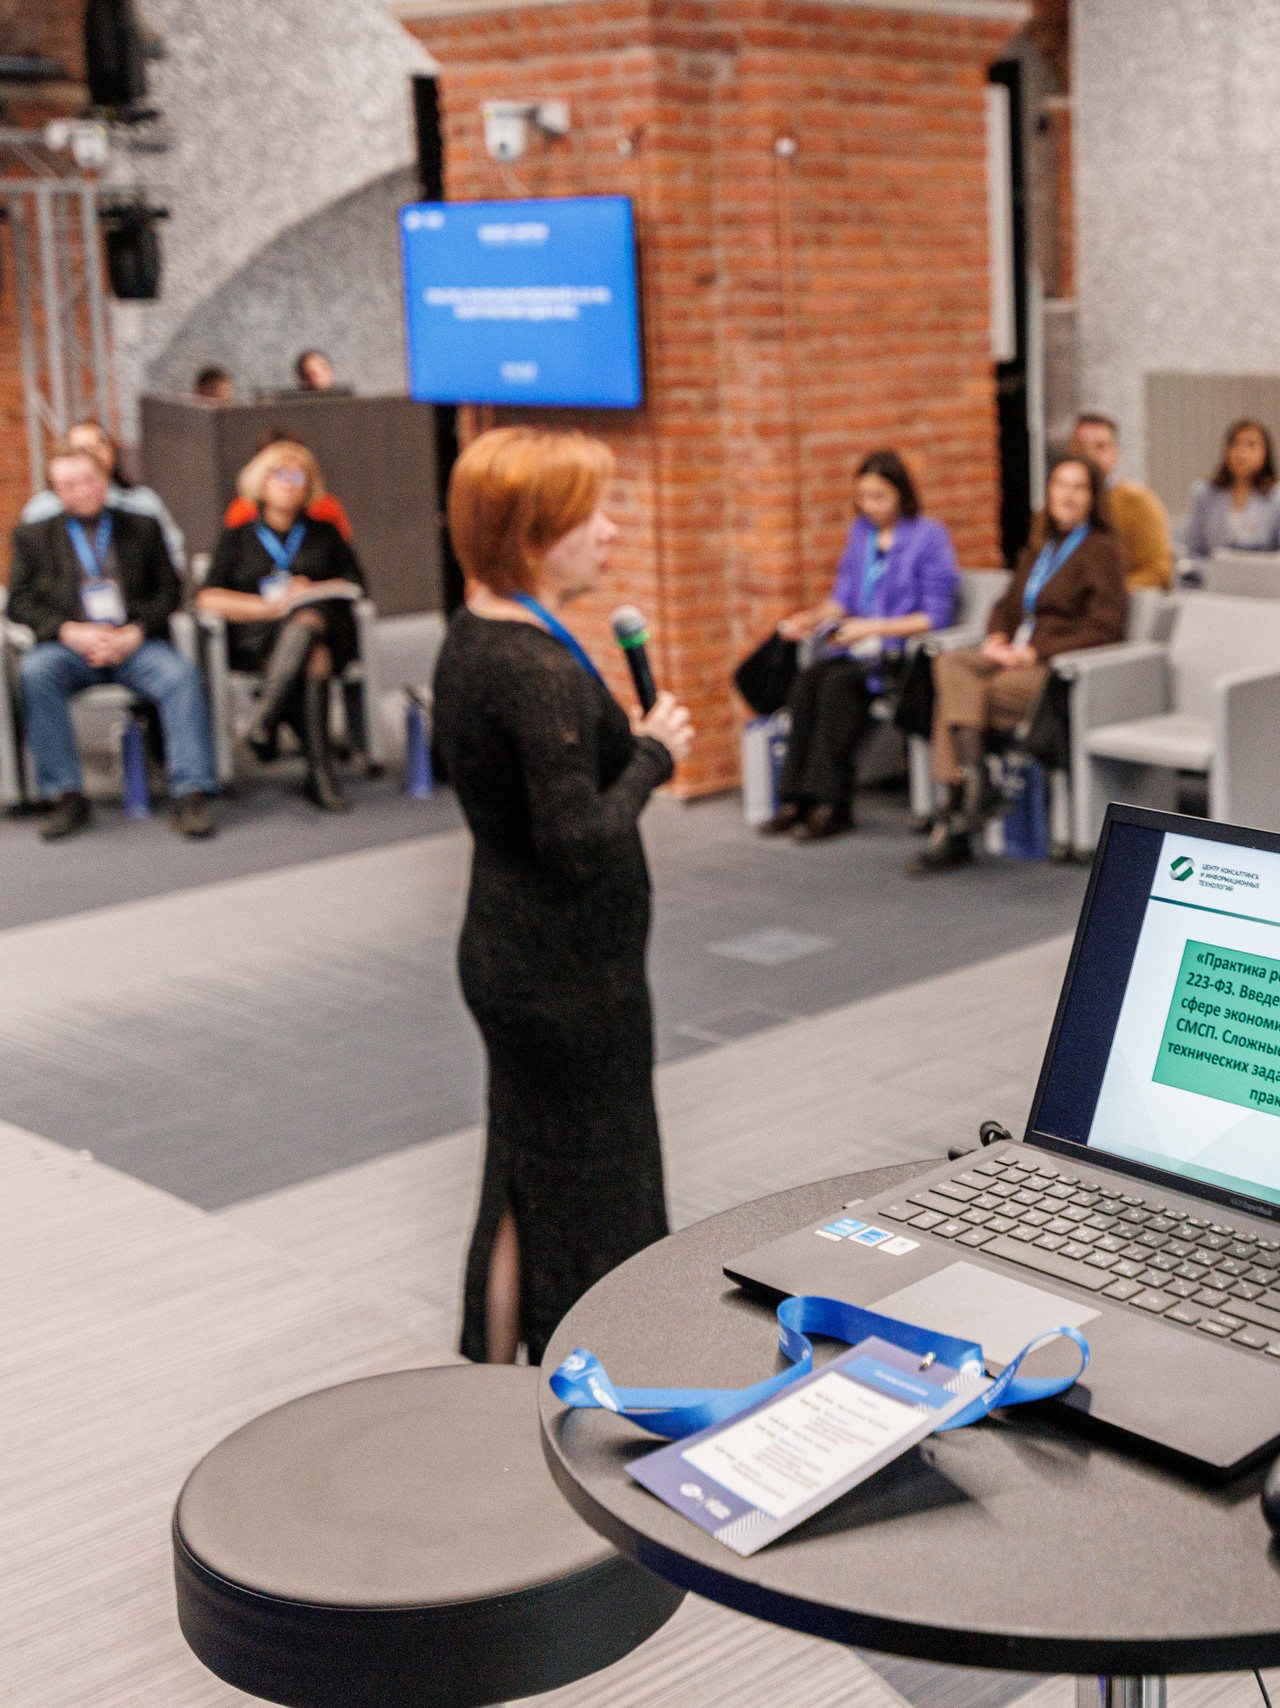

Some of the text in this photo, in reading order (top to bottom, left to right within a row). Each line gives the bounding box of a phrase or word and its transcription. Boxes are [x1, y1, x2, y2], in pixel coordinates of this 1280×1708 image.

[1205, 873, 1260, 888] ИНФОРМАЦИОННЫХ
[1221, 868, 1259, 879] КОНСАЛТИНГА
[1199, 880, 1234, 891] ТЕХНОЛОГИЙ
[1196, 951, 1267, 979] «Практика
[1186, 972, 1235, 996] 223-ФЗ.
[1180, 997, 1221, 1018] сфере
[1176, 1018, 1218, 1040] СМСП.
[1167, 1040, 1249, 1073] технических
